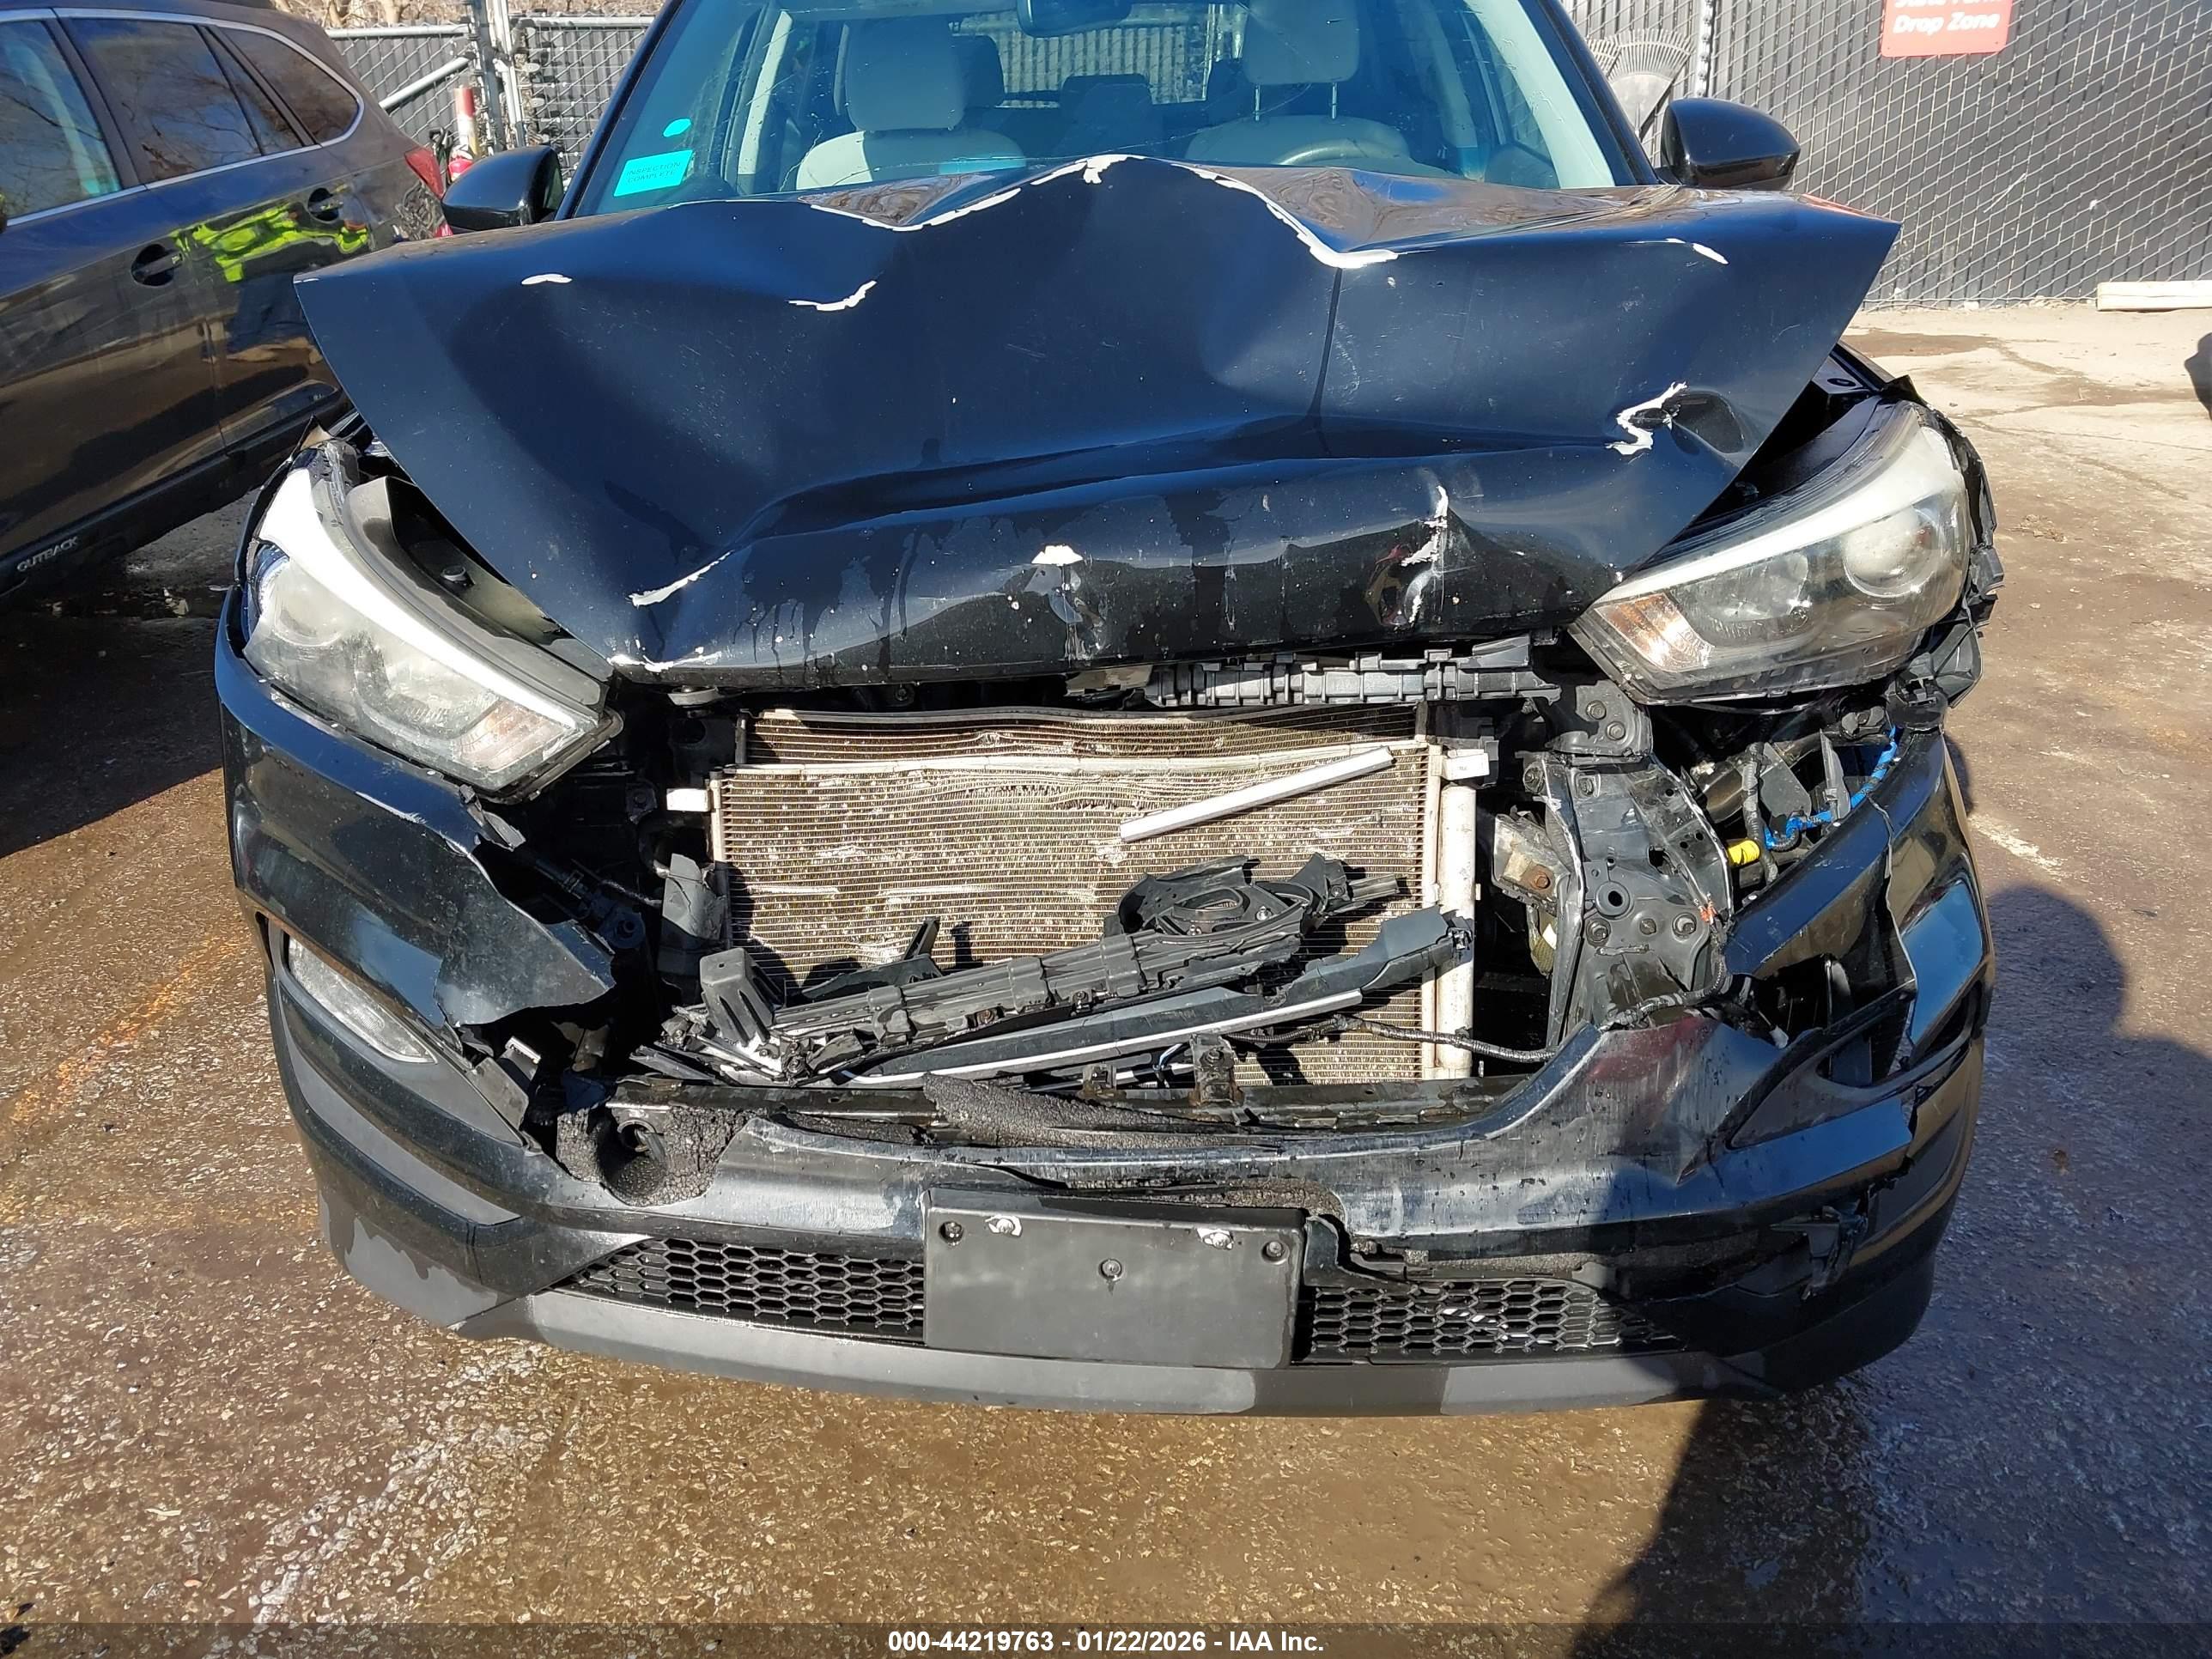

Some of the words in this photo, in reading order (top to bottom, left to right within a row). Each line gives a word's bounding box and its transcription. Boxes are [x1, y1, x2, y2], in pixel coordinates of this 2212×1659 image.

[1892, 15, 1945, 35] Drop
[1947, 11, 2001, 31] Zone
[626, 161, 681, 177] INSPECTION
[16, 535, 78, 572] OUTBACK
